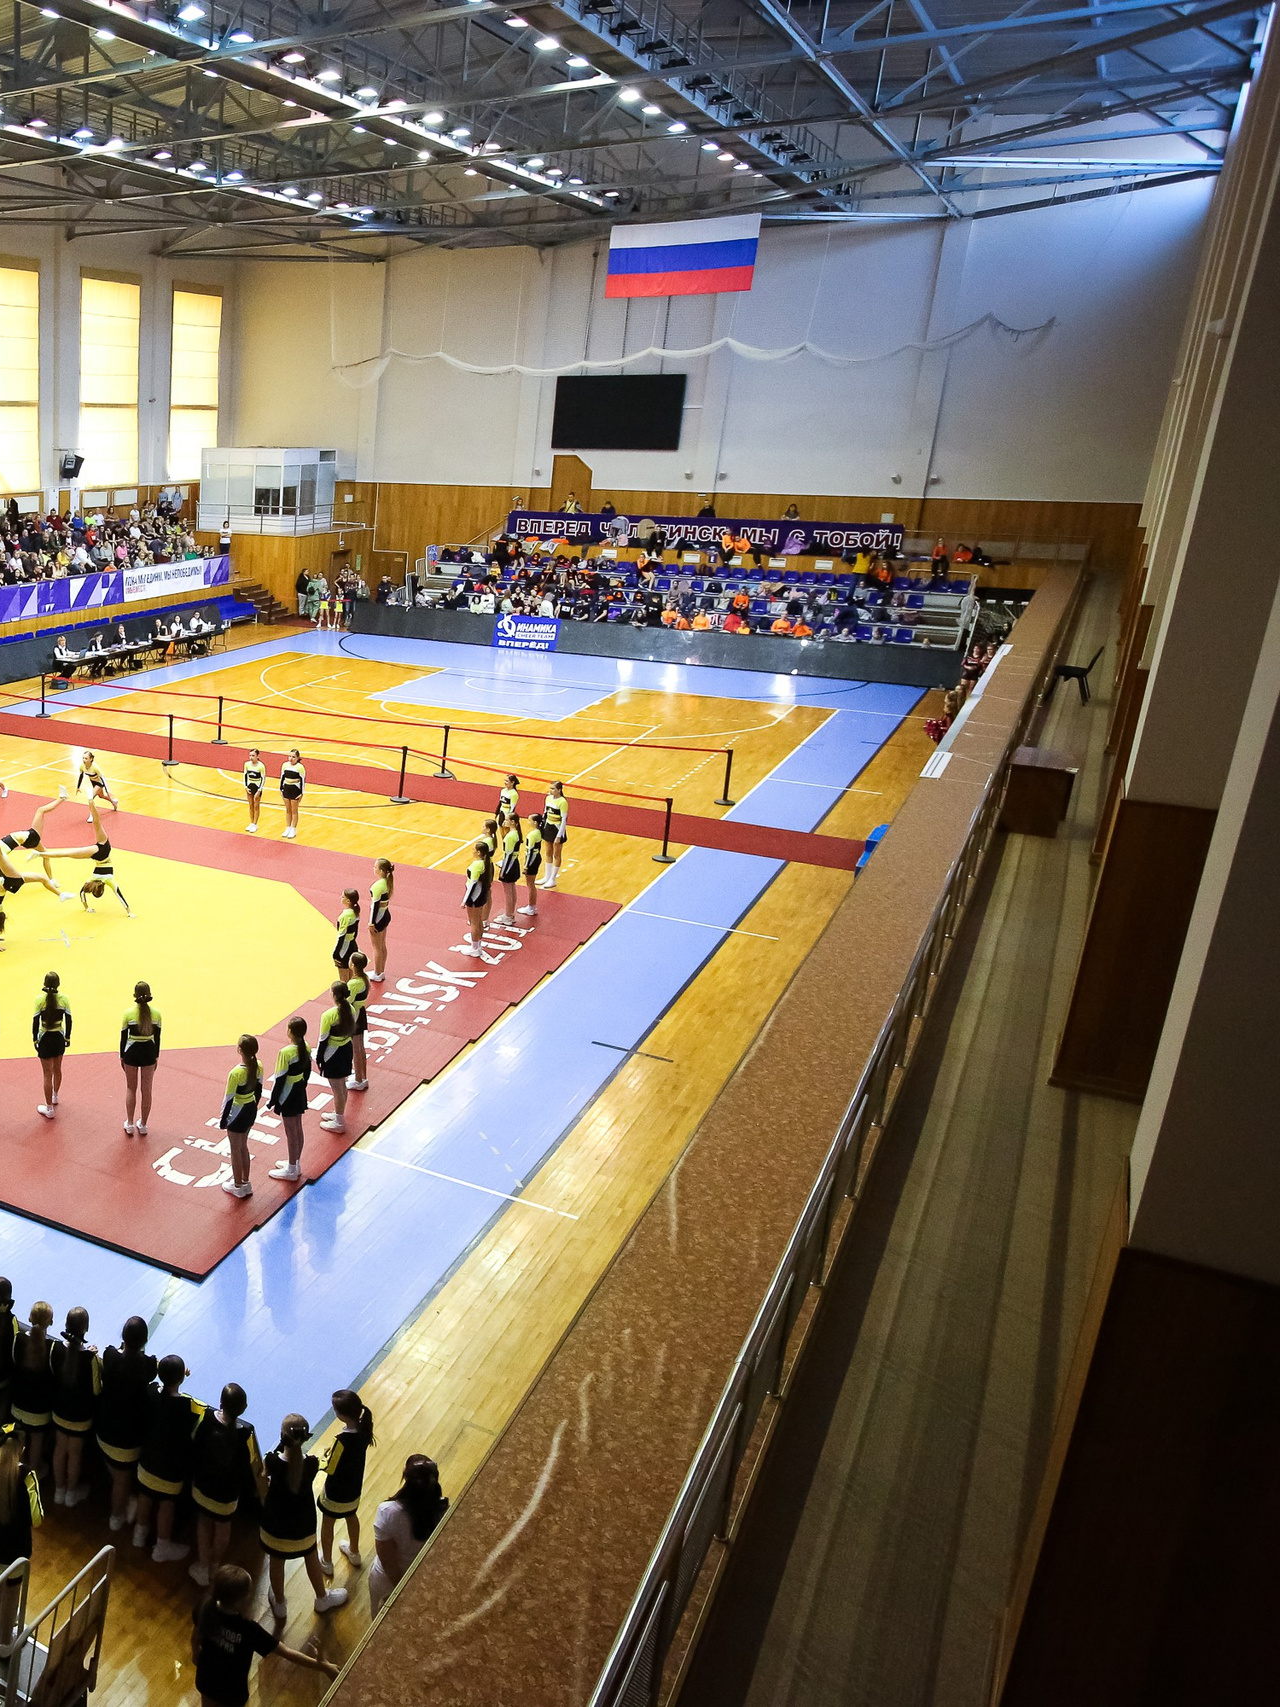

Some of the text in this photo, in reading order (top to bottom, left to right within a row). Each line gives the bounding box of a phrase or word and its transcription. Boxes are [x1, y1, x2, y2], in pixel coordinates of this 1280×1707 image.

[516, 518, 591, 536] ВПЕРЕД
[740, 527, 779, 545] МЫ
[813, 529, 902, 549] ТОБОЙ!
